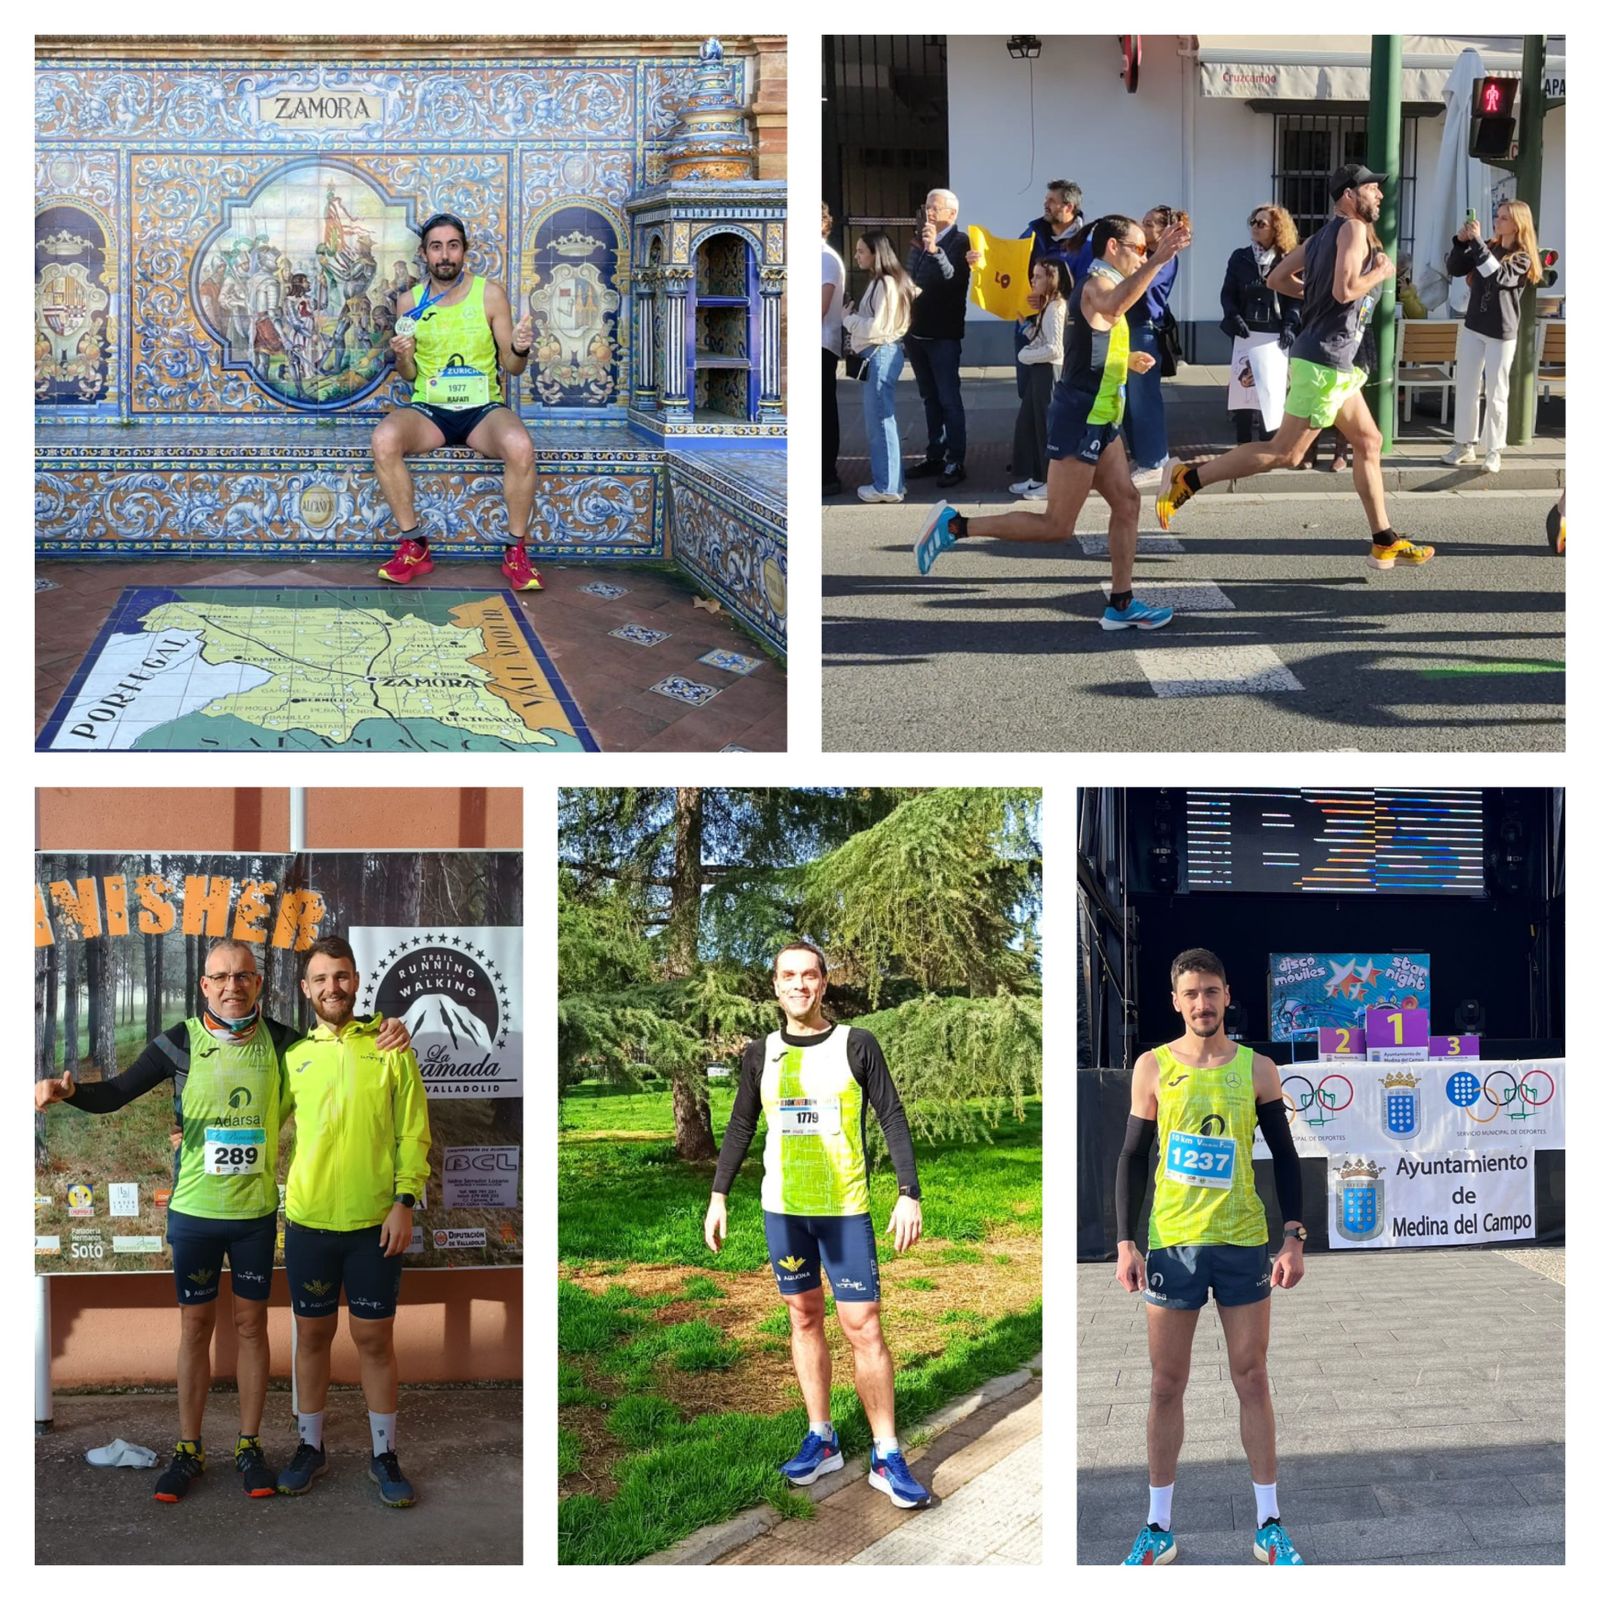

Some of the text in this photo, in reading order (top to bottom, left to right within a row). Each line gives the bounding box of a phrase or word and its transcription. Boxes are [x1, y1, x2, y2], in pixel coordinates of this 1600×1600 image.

[1222, 71, 1277, 84] Cruzcampo
[274, 97, 371, 119] ZAMORA
[448, 384, 467, 392] 1977
[69, 638, 191, 740] PORTUGAL
[382, 678, 482, 689] ZAMORA
[422, 954, 453, 962] TRAIL
[1278, 956, 1316, 974] disco
[1391, 956, 1428, 977] star
[398, 960, 475, 979] RUNNING
[399, 978, 476, 997] WALKING
[1385, 968, 1426, 990] night
[1387, 1013, 1403, 1045] 1
[1335, 1028, 1351, 1053] 2
[1447, 1036, 1461, 1055] 3
[424, 1044, 451, 1063] La
[424, 1084, 500, 1093] VALLADOLID
[214, 1114, 261, 1128] Adarsa
[796, 1111, 819, 1124] 1779
[1180, 1136, 1193, 1144] km
[214, 1147, 259, 1165] 289
[445, 1153, 517, 1171] BCL
[1172, 1147, 1230, 1171] 1237
[1396, 1154, 1528, 1179] Ayuntamiento
[1452, 1186, 1476, 1204] de
[1392, 1213, 1531, 1237] Medina del Campo
[71, 1242, 104, 1259] Soto
